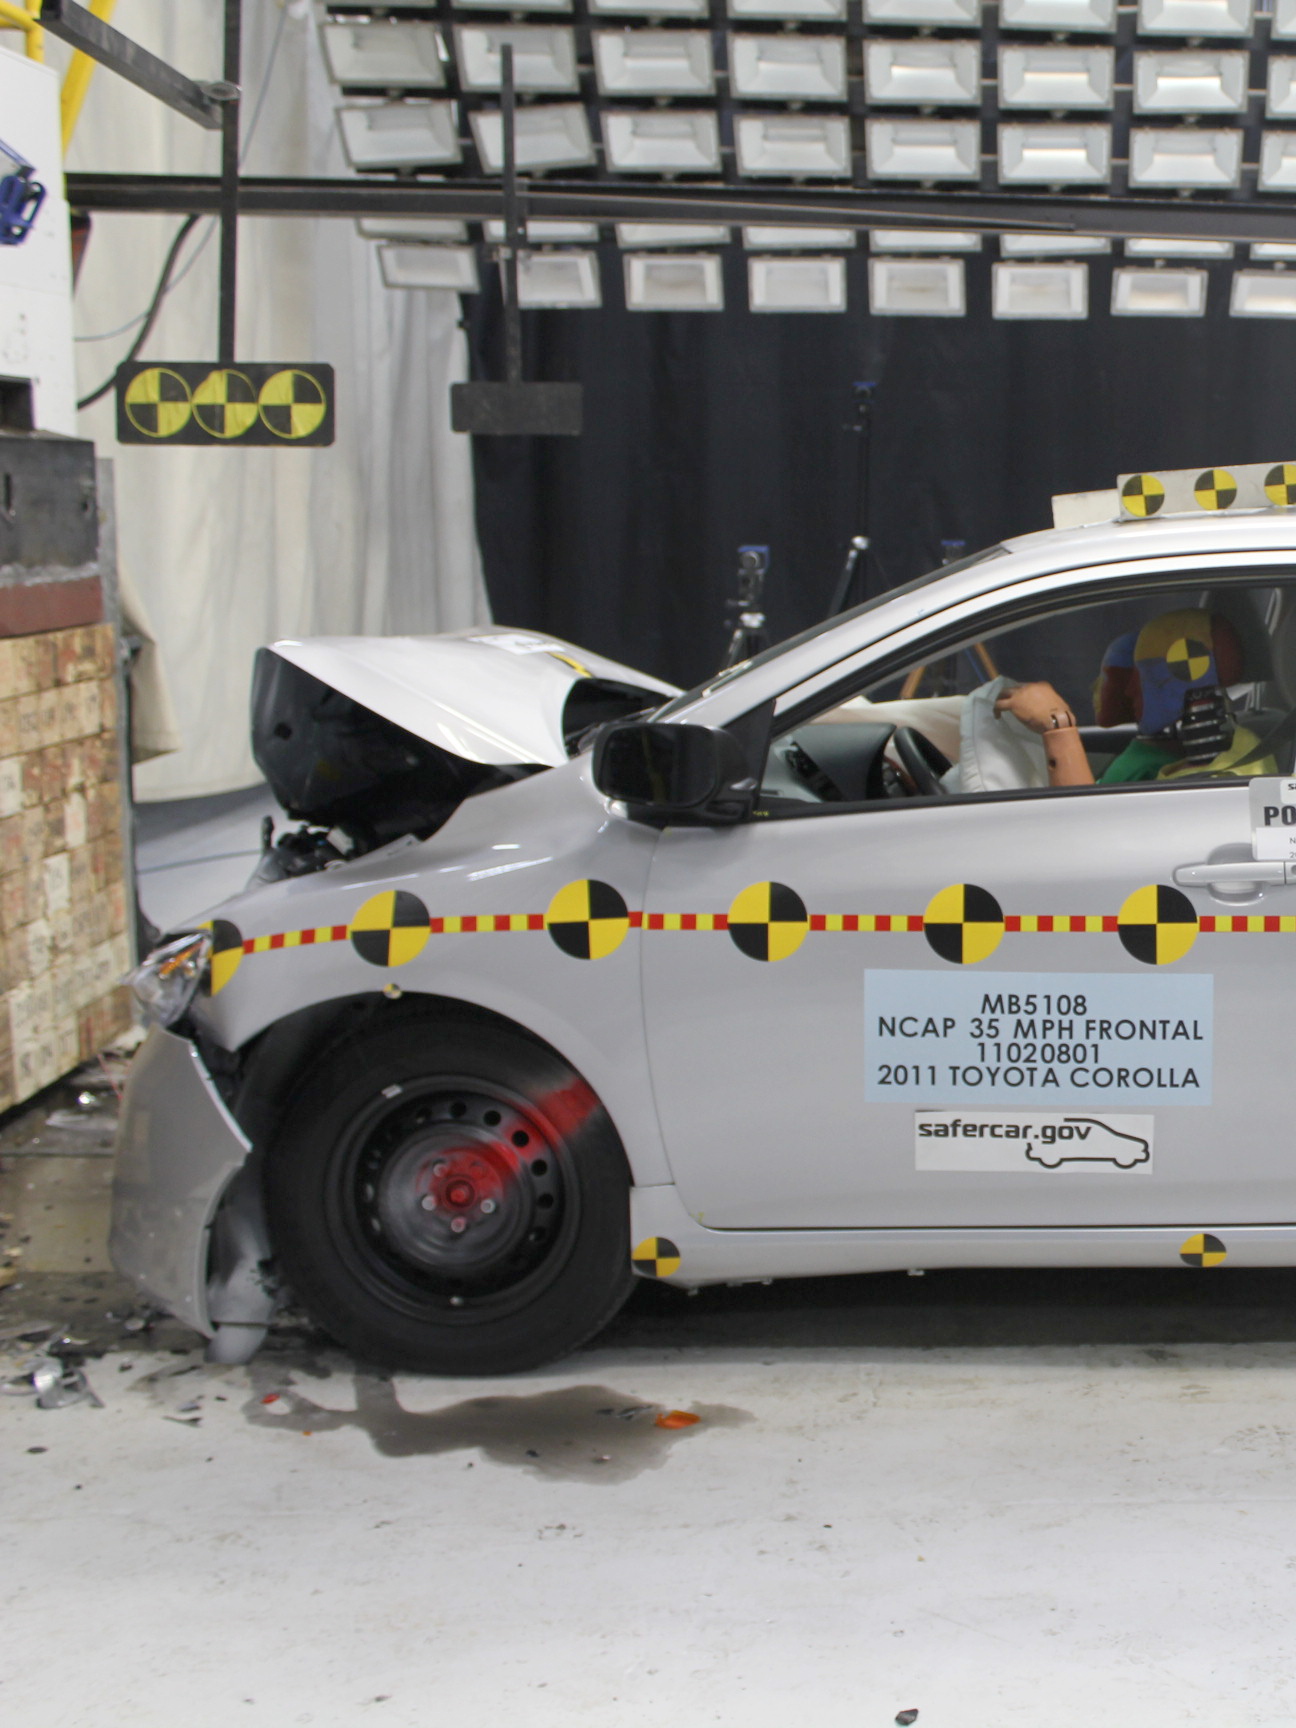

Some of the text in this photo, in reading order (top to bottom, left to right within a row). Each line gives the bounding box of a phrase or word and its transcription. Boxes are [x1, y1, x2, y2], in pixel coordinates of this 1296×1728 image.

[980, 994, 1088, 1016] MB5108
[878, 1017, 1203, 1041] NCAP 35 MPH FRONTAL
[977, 1042, 1100, 1064] 11020801
[877, 1065, 1200, 1088] 2011 TOYOTA COROLLA
[918, 1118, 1092, 1144] safercar.gov
